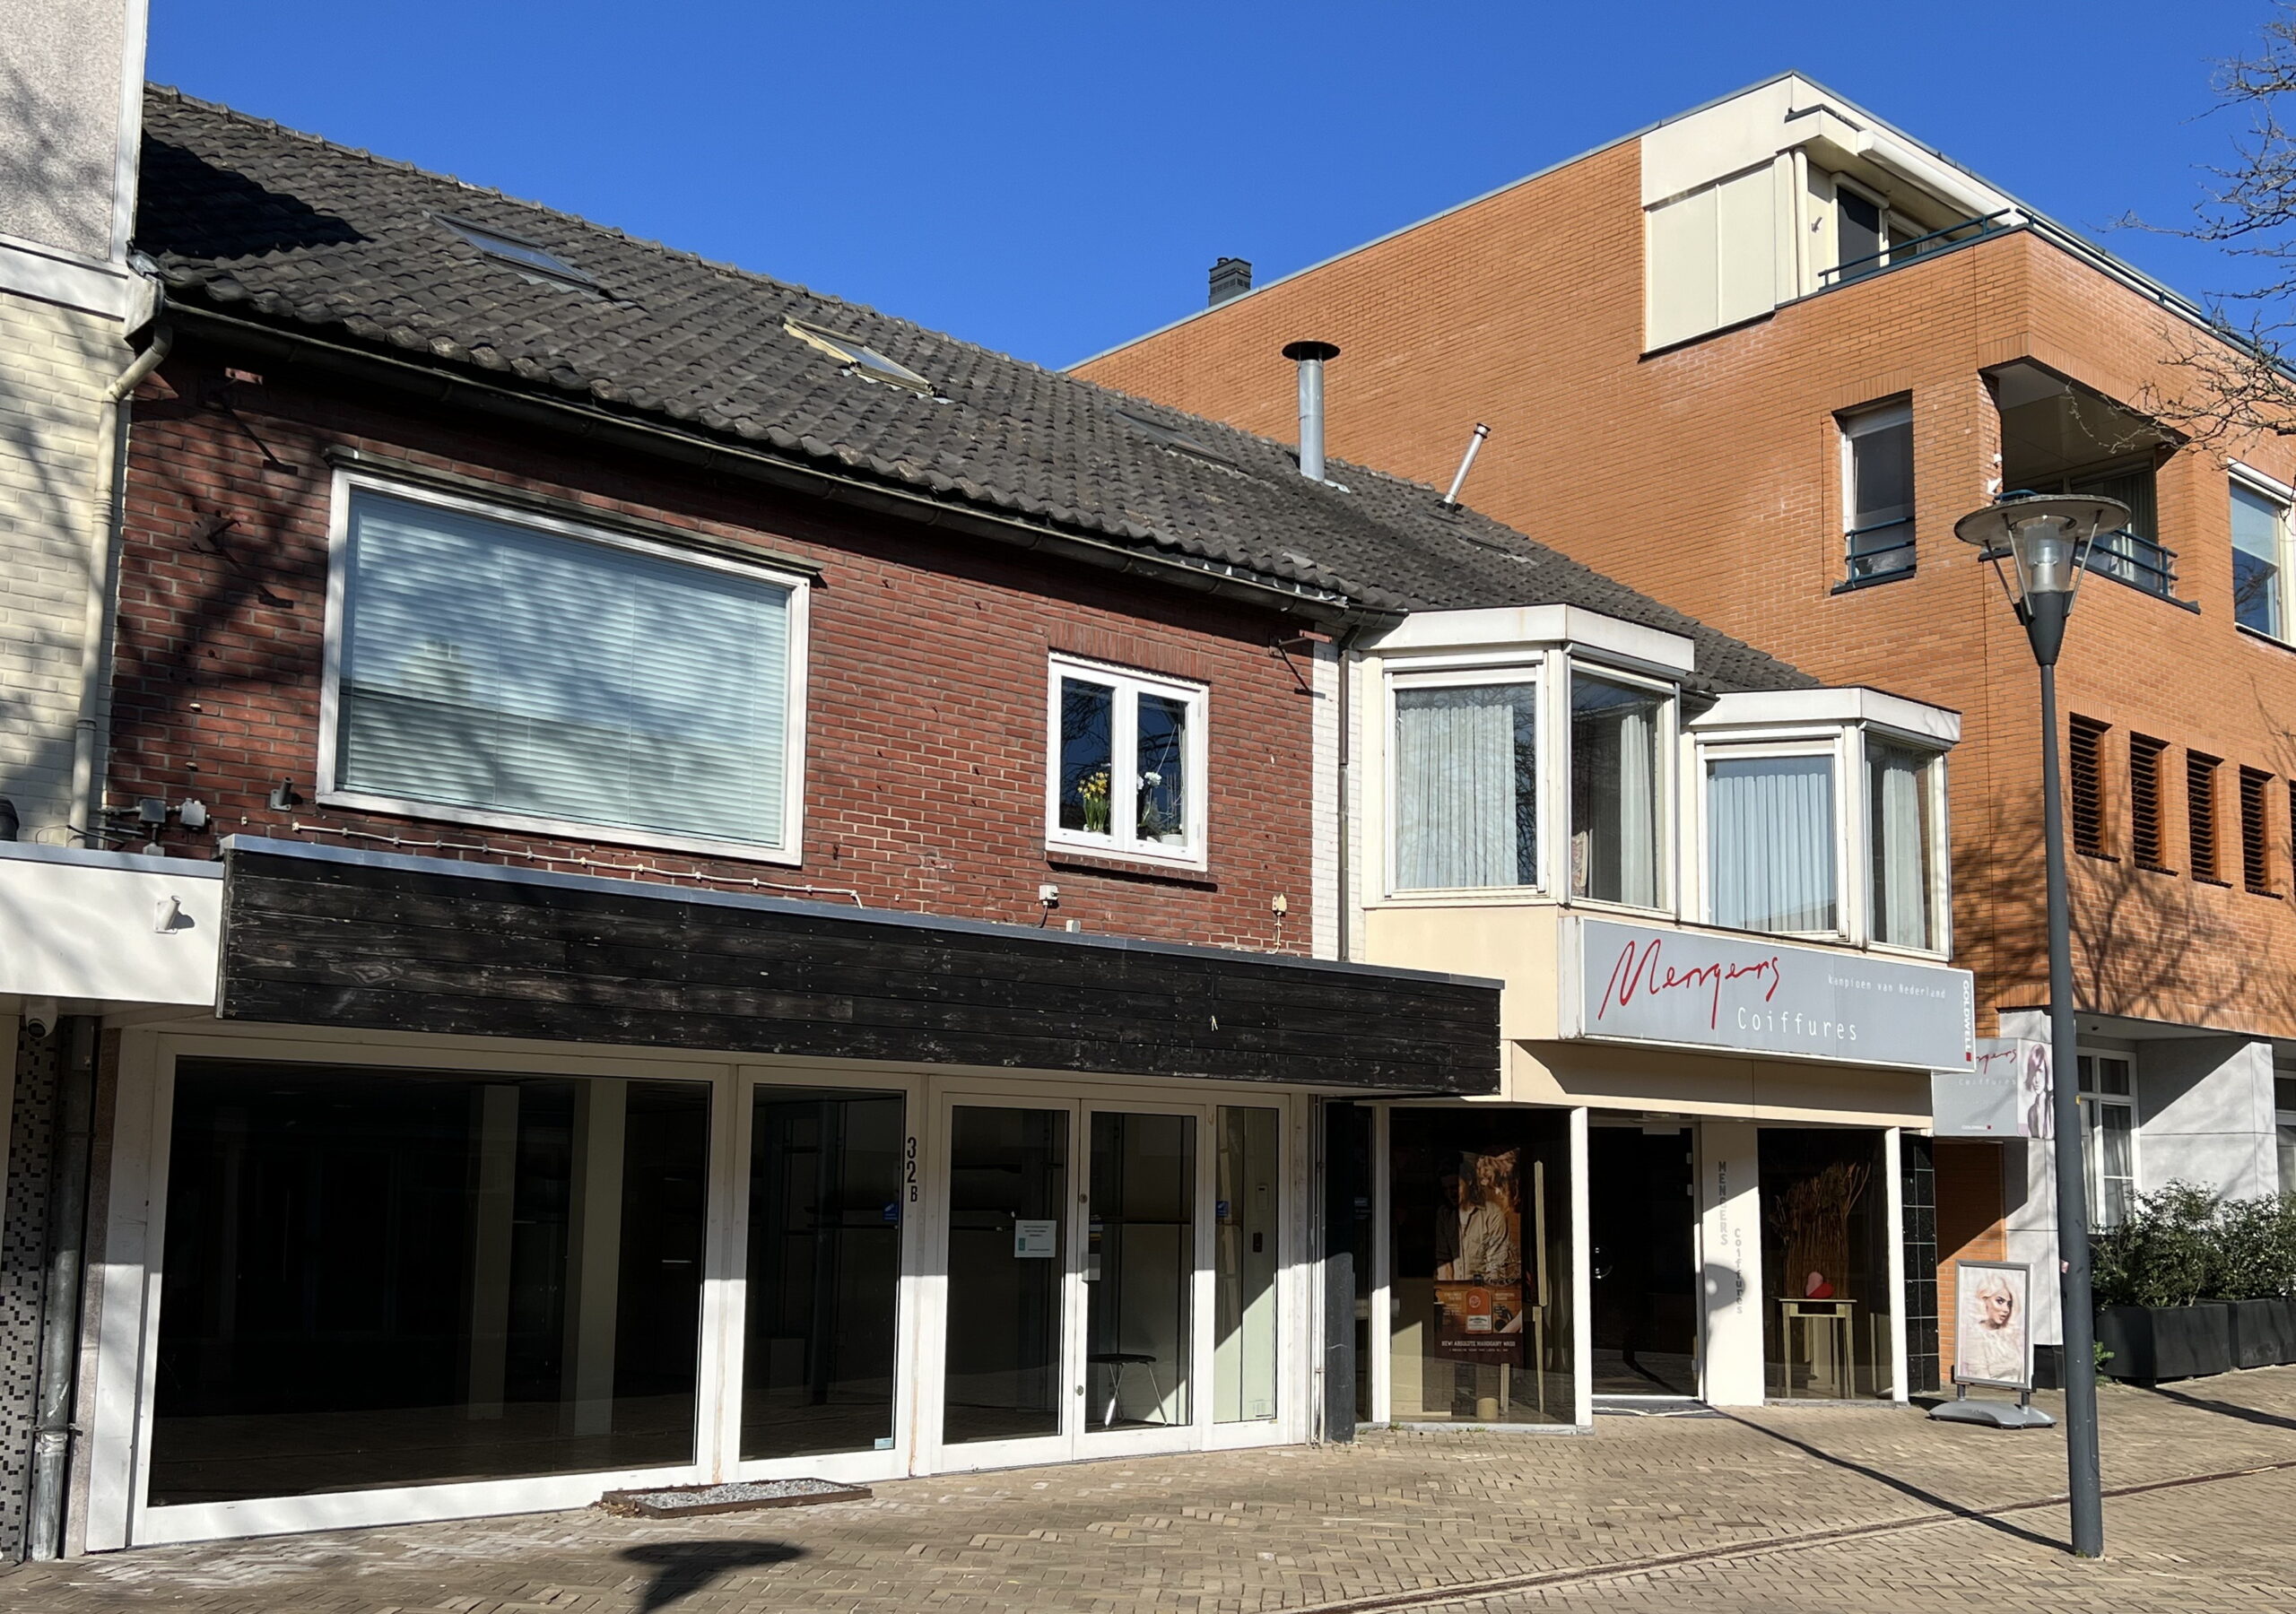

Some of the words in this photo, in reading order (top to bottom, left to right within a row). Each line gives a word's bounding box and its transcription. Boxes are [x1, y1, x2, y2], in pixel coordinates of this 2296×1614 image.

[1597, 939, 1779, 1030] Mengers
[1737, 1006, 1857, 1040] Coiffures
[1877, 983, 1893, 993] van
[1899, 984, 1946, 999] Nederland
[1962, 979, 1972, 1052] GOLDWELL
[1718, 1161, 1728, 1245] MENGERS
[1735, 1228, 1743, 1315] Coiffures
